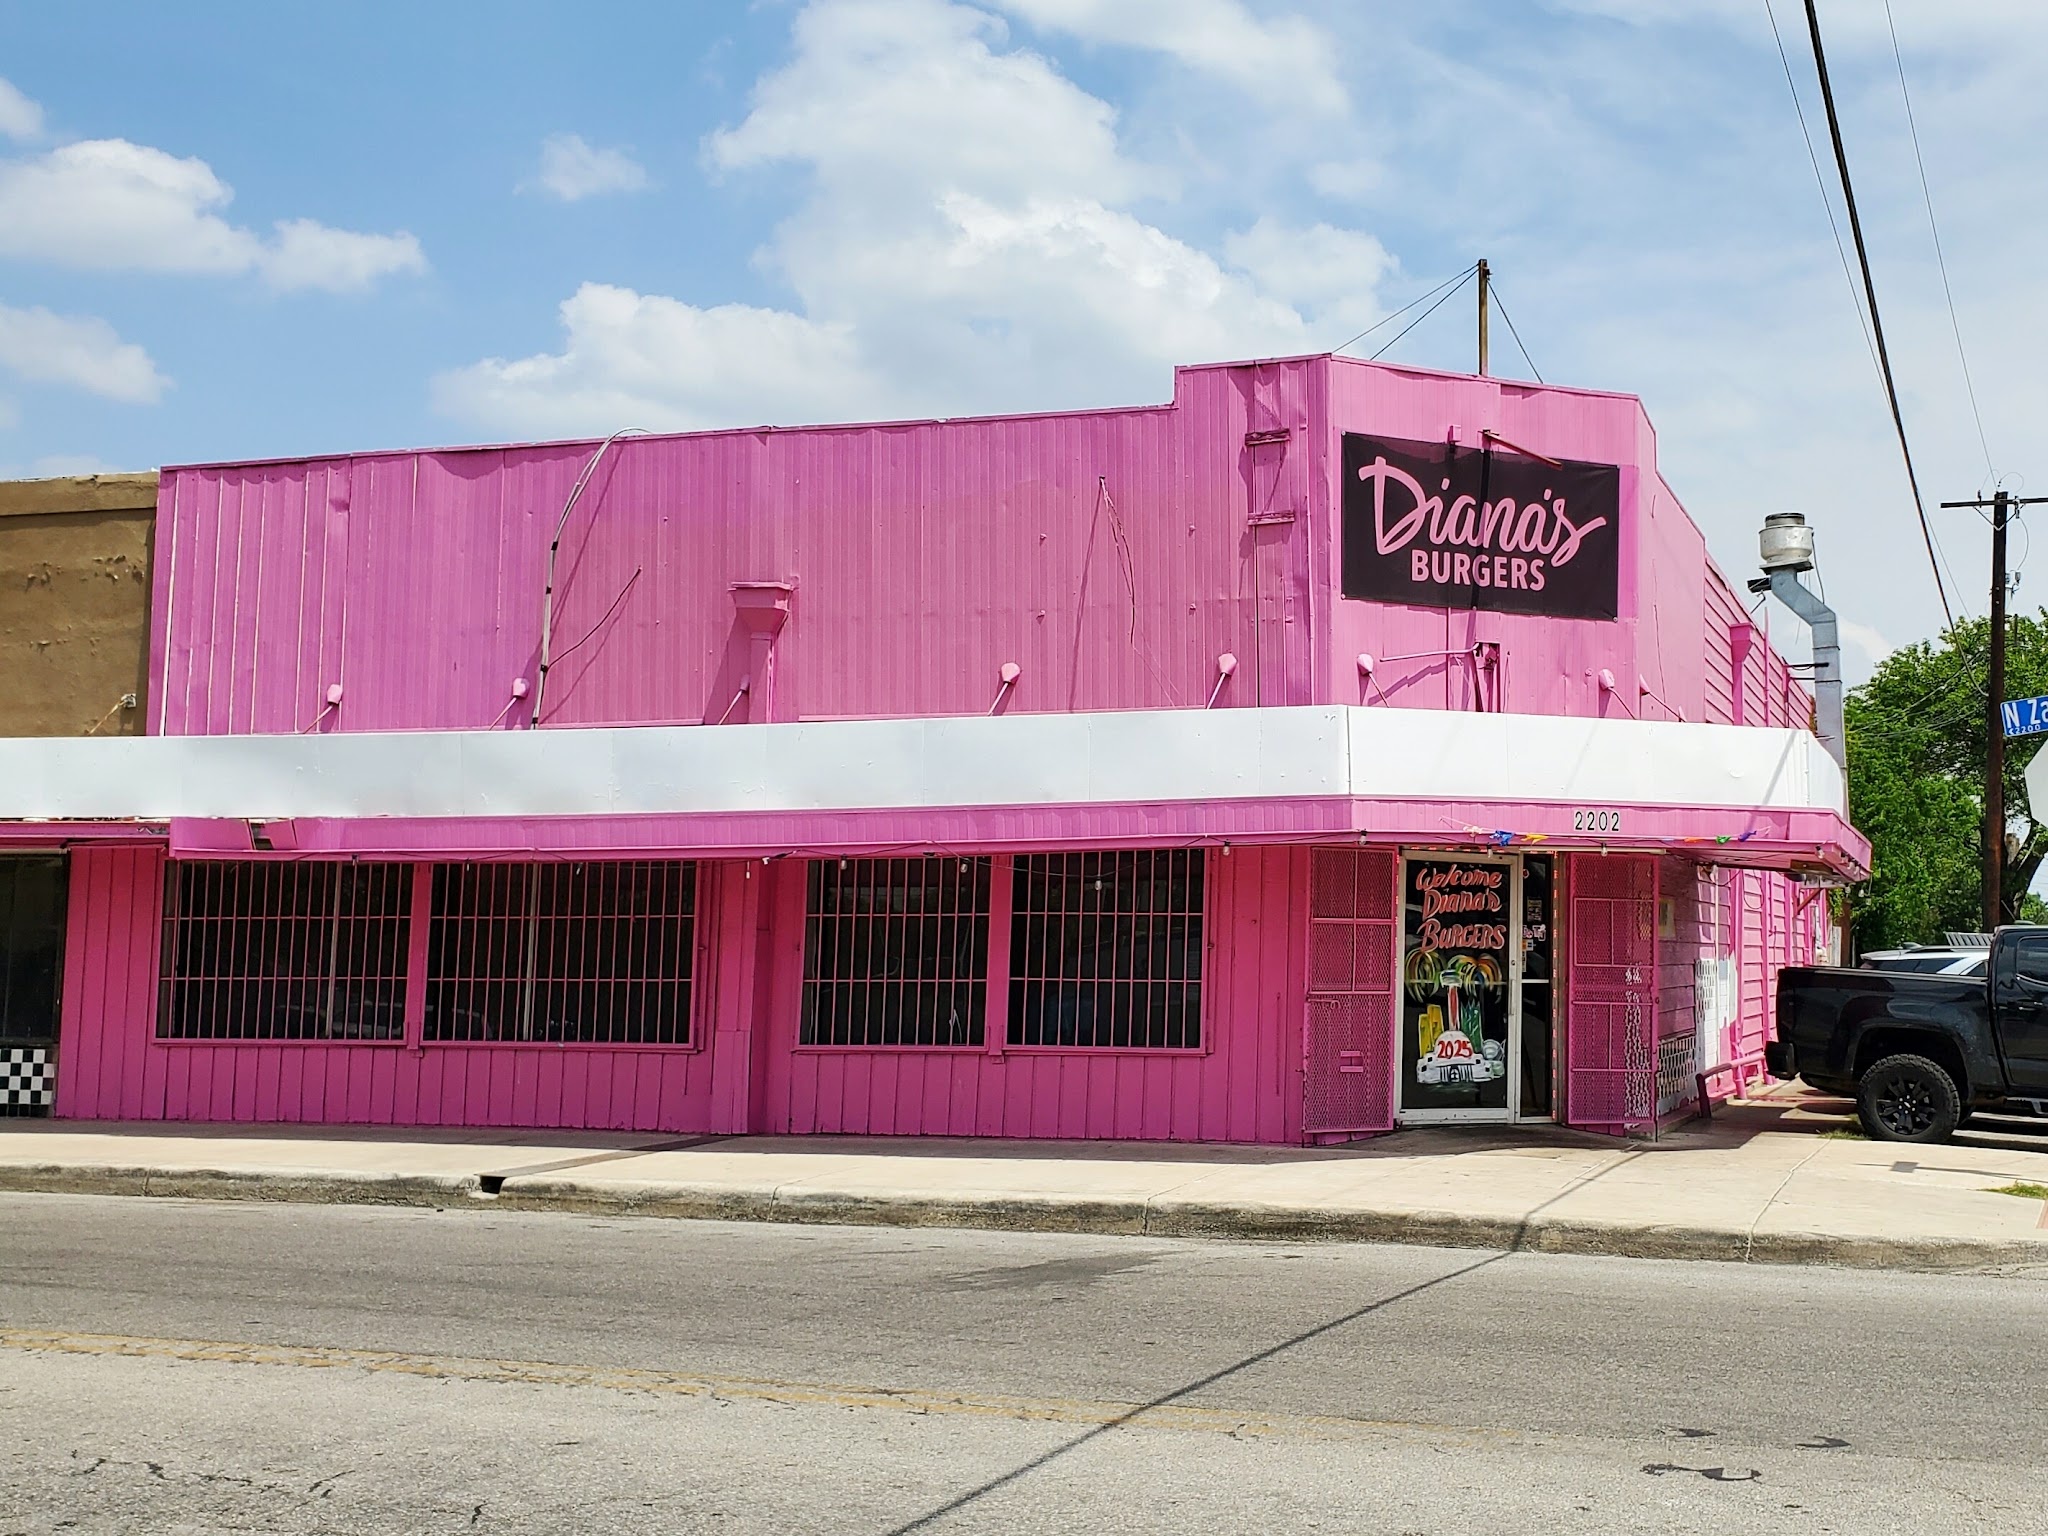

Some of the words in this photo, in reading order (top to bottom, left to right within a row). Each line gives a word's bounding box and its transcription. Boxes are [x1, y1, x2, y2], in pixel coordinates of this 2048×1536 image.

[1358, 455, 1607, 568] Diana's
[1410, 549, 1546, 592] BURGERS
[2004, 702, 2020, 728] N
[2015, 724, 2041, 734] 2200
[1574, 811, 1620, 832] 2202
[1416, 864, 1502, 891] Welcome
[1423, 888, 1502, 921] Diana's
[1437, 1039, 1473, 1059] 2025
